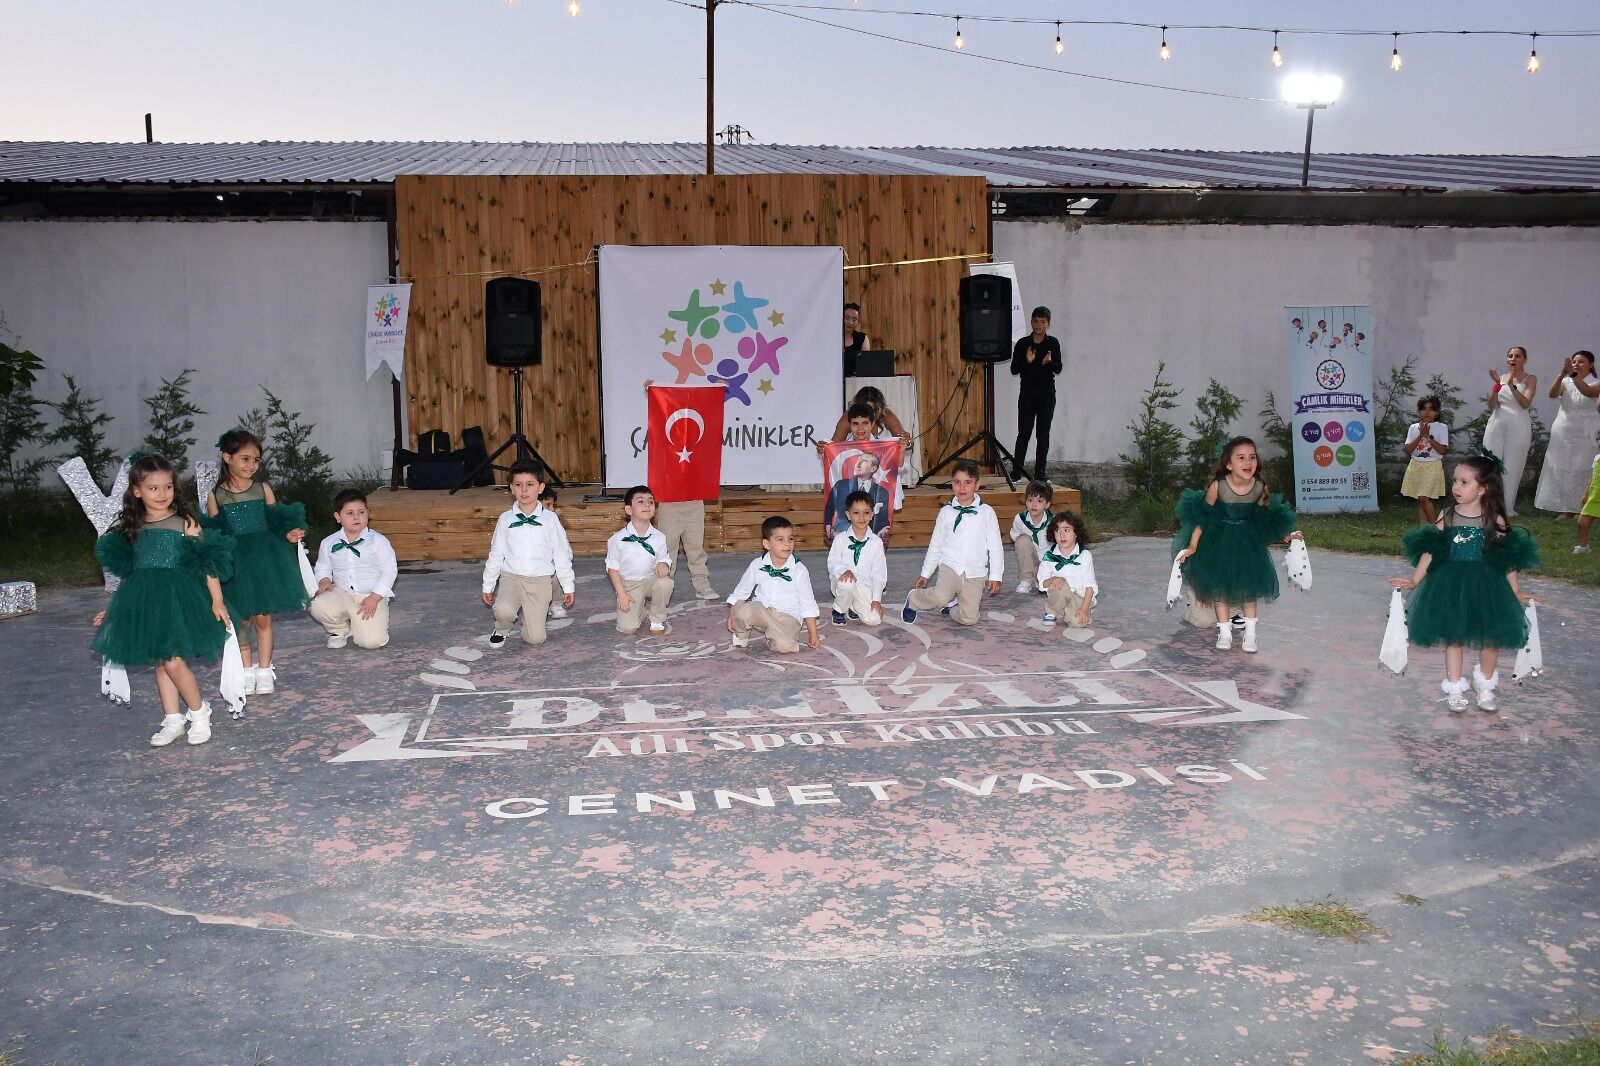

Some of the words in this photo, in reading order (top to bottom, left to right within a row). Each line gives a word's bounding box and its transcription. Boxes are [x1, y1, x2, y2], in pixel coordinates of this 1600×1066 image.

[1301, 395, 1328, 408] ÇAMLIK
[585, 733, 693, 758] Atlı
[707, 730, 852, 753] Spor
[874, 717, 1101, 742] Kulübü
[485, 779, 899, 819] CENNET
